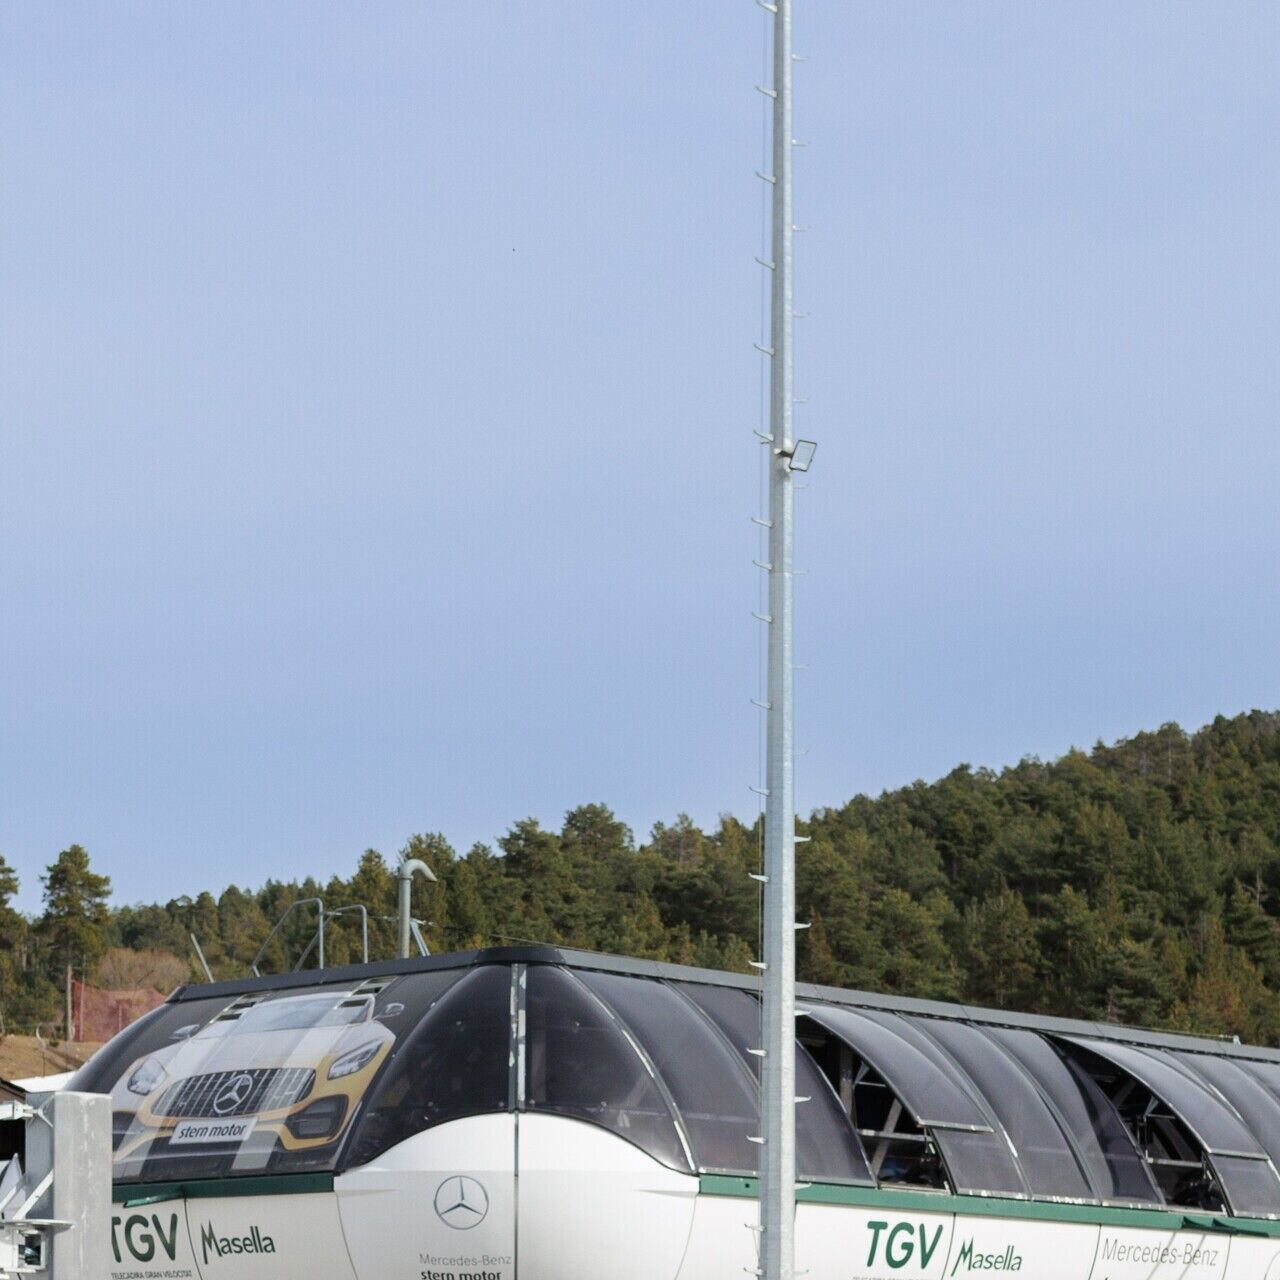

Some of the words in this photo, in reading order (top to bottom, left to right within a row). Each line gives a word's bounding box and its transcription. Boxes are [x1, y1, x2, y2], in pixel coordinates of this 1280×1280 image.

[179, 1125, 208, 1138] stern
[209, 1124, 247, 1137] motor
[201, 1219, 276, 1265] Masella
[867, 1220, 943, 1269] TGV
[951, 1238, 1022, 1277] Masella
[1101, 1238, 1219, 1267] Mercedes-Benz
[419, 1253, 512, 1266] Mercedes-Benz
